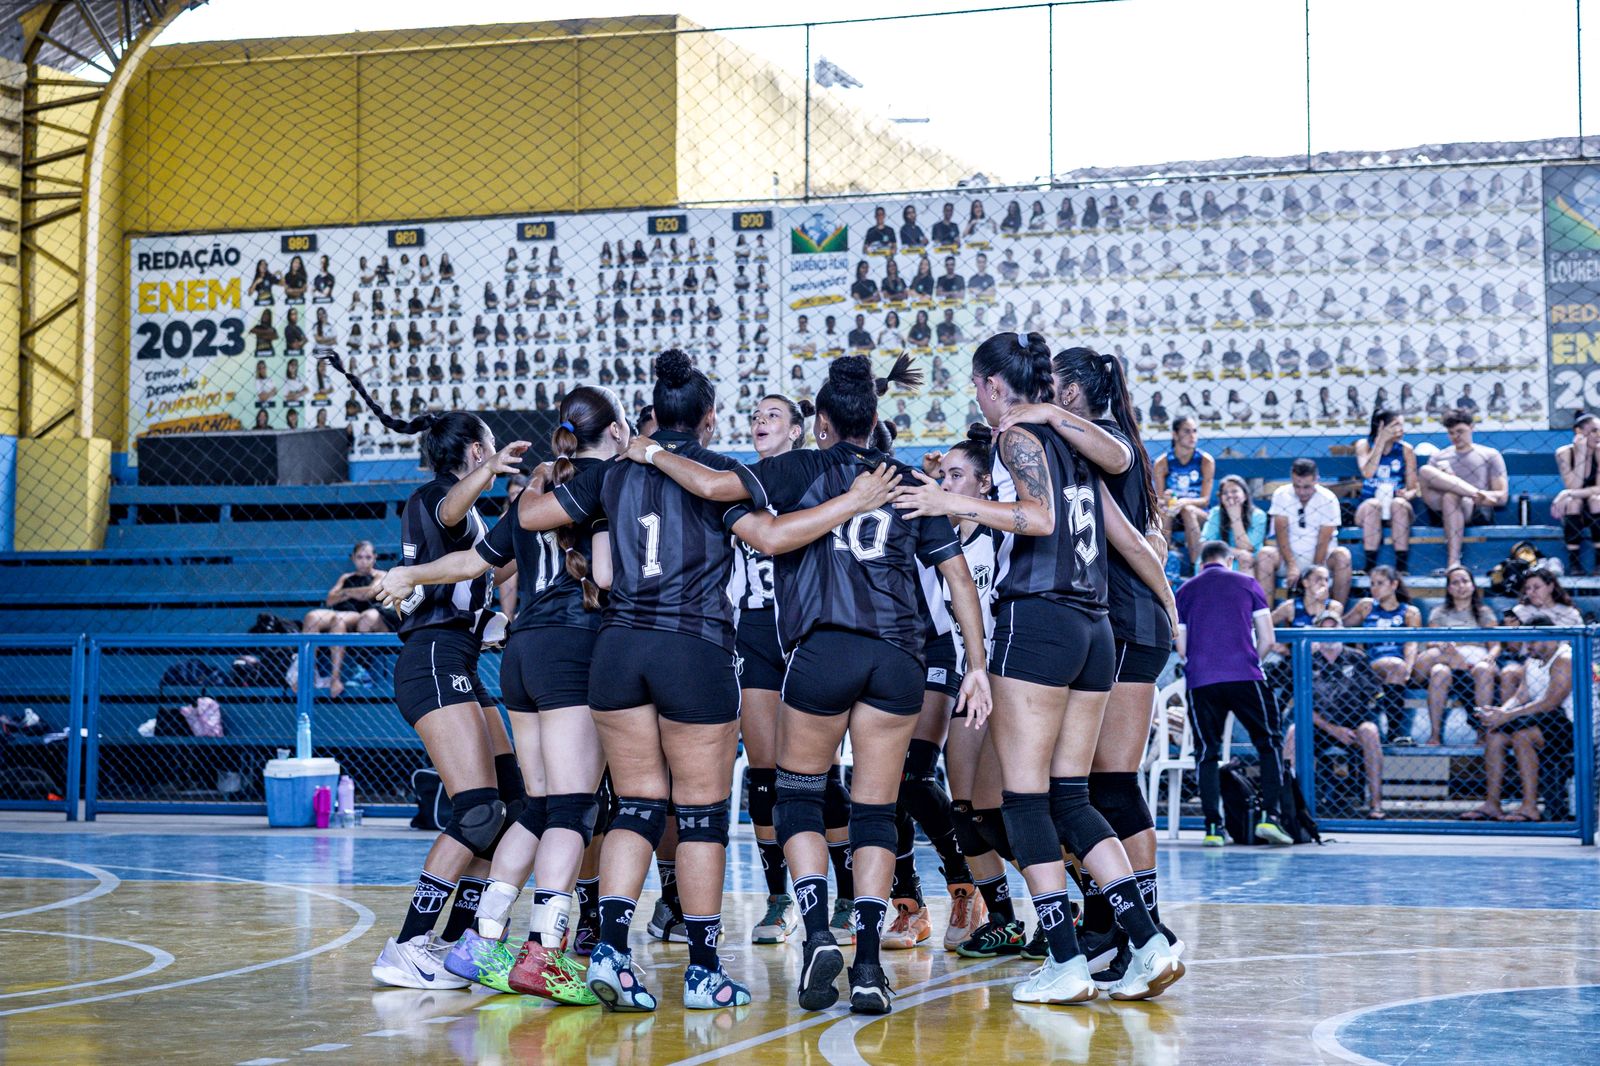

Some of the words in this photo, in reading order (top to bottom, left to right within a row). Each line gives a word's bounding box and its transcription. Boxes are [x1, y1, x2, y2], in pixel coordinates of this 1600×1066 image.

[524, 223, 548, 238] 940
[656, 217, 679, 232] 920
[138, 243, 241, 274] REDAÇÃO
[138, 277, 242, 314] ENEM
[1552, 304, 1600, 323] RED
[136, 317, 246, 359] 2023
[638, 511, 664, 579] 1
